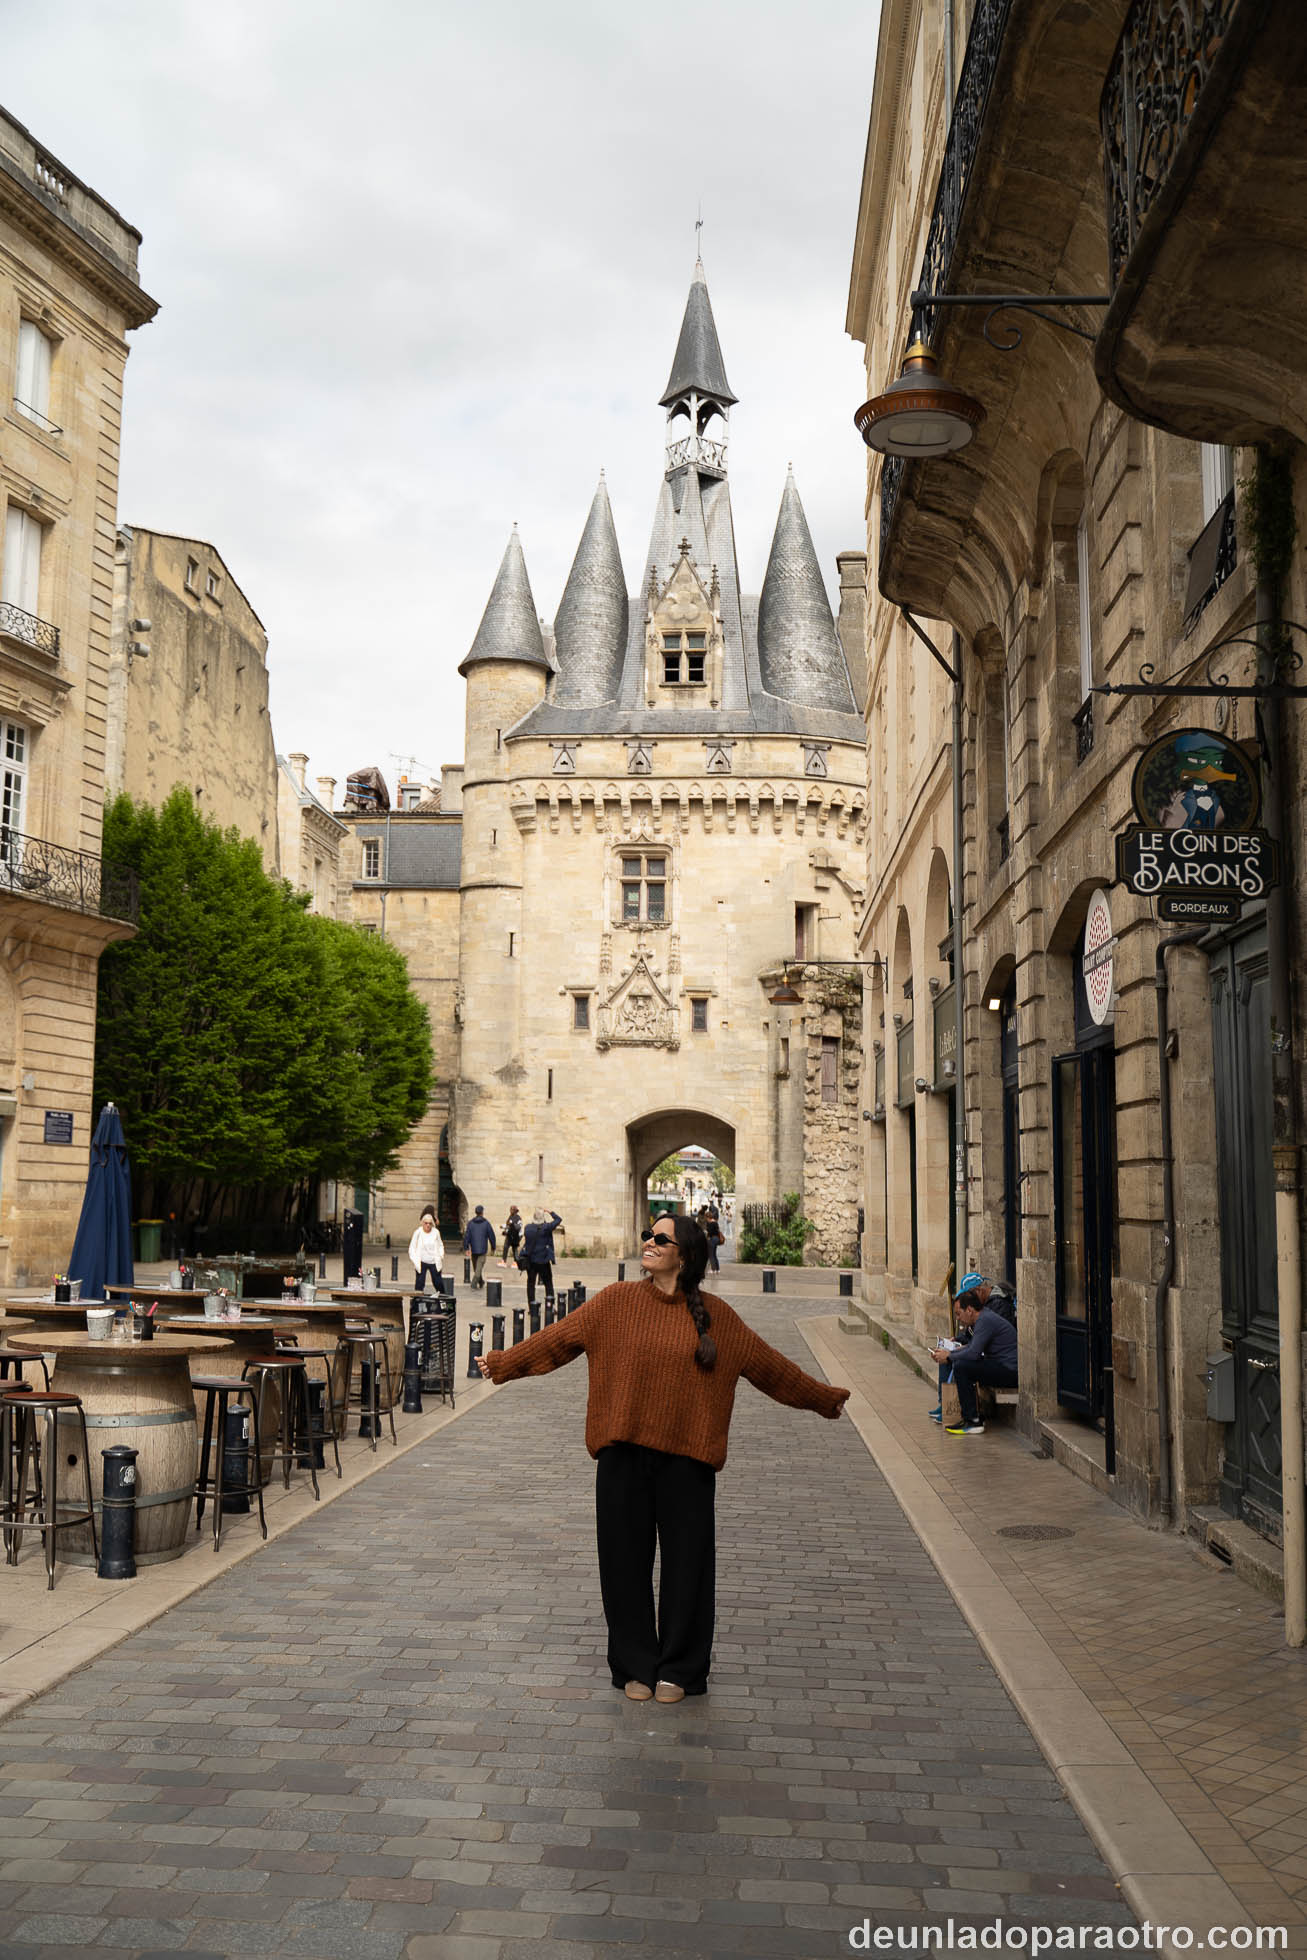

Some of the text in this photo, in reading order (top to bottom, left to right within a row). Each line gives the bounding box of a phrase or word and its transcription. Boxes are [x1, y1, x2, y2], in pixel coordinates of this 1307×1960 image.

[1138, 828, 1261, 858] LE COIN DES
[1133, 853, 1264, 896] BARONS
[1170, 902, 1229, 914] BORDEAUX
